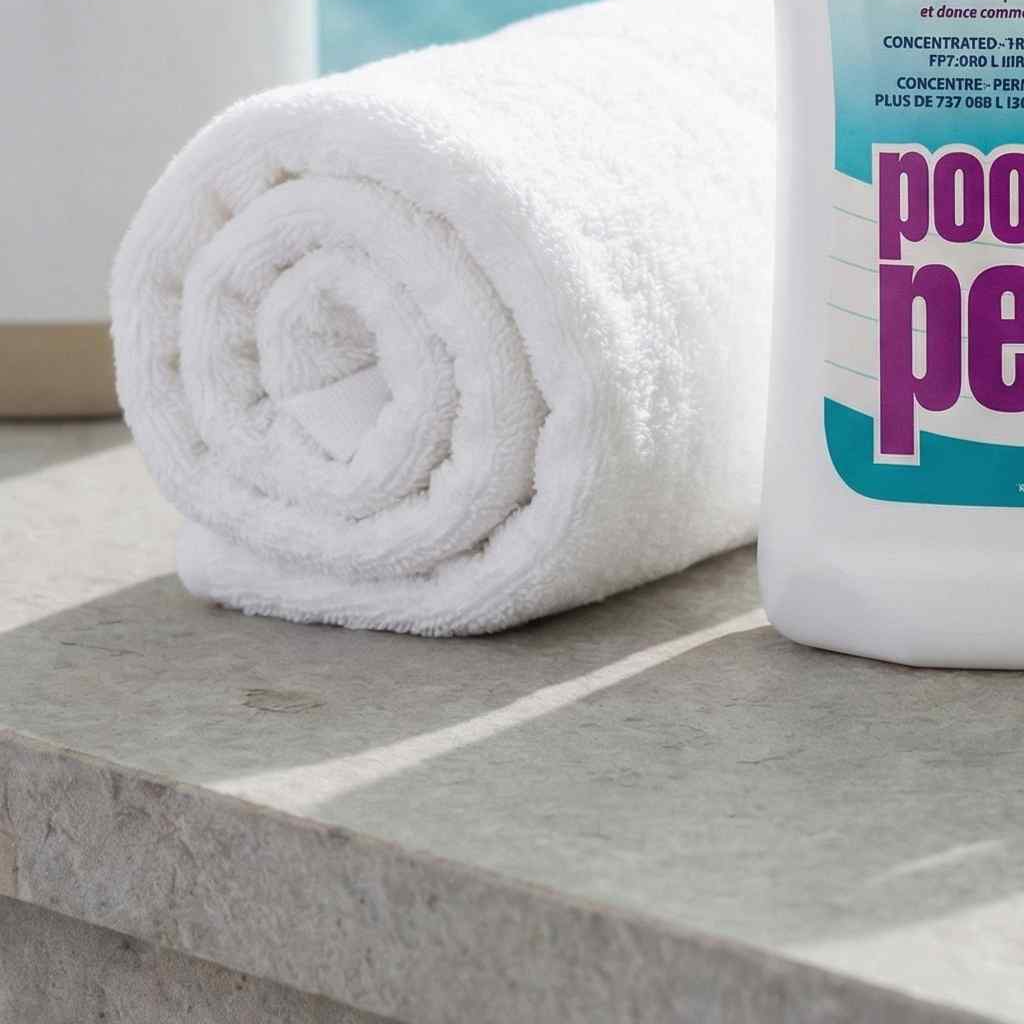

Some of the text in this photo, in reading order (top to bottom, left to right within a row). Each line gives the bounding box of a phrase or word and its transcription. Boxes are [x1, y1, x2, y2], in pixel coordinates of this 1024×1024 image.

[920, 6, 934, 18] et
[875, 94, 911, 107] PLUS
[914, 95, 933, 108] DE
[936, 96, 961, 108] 737
